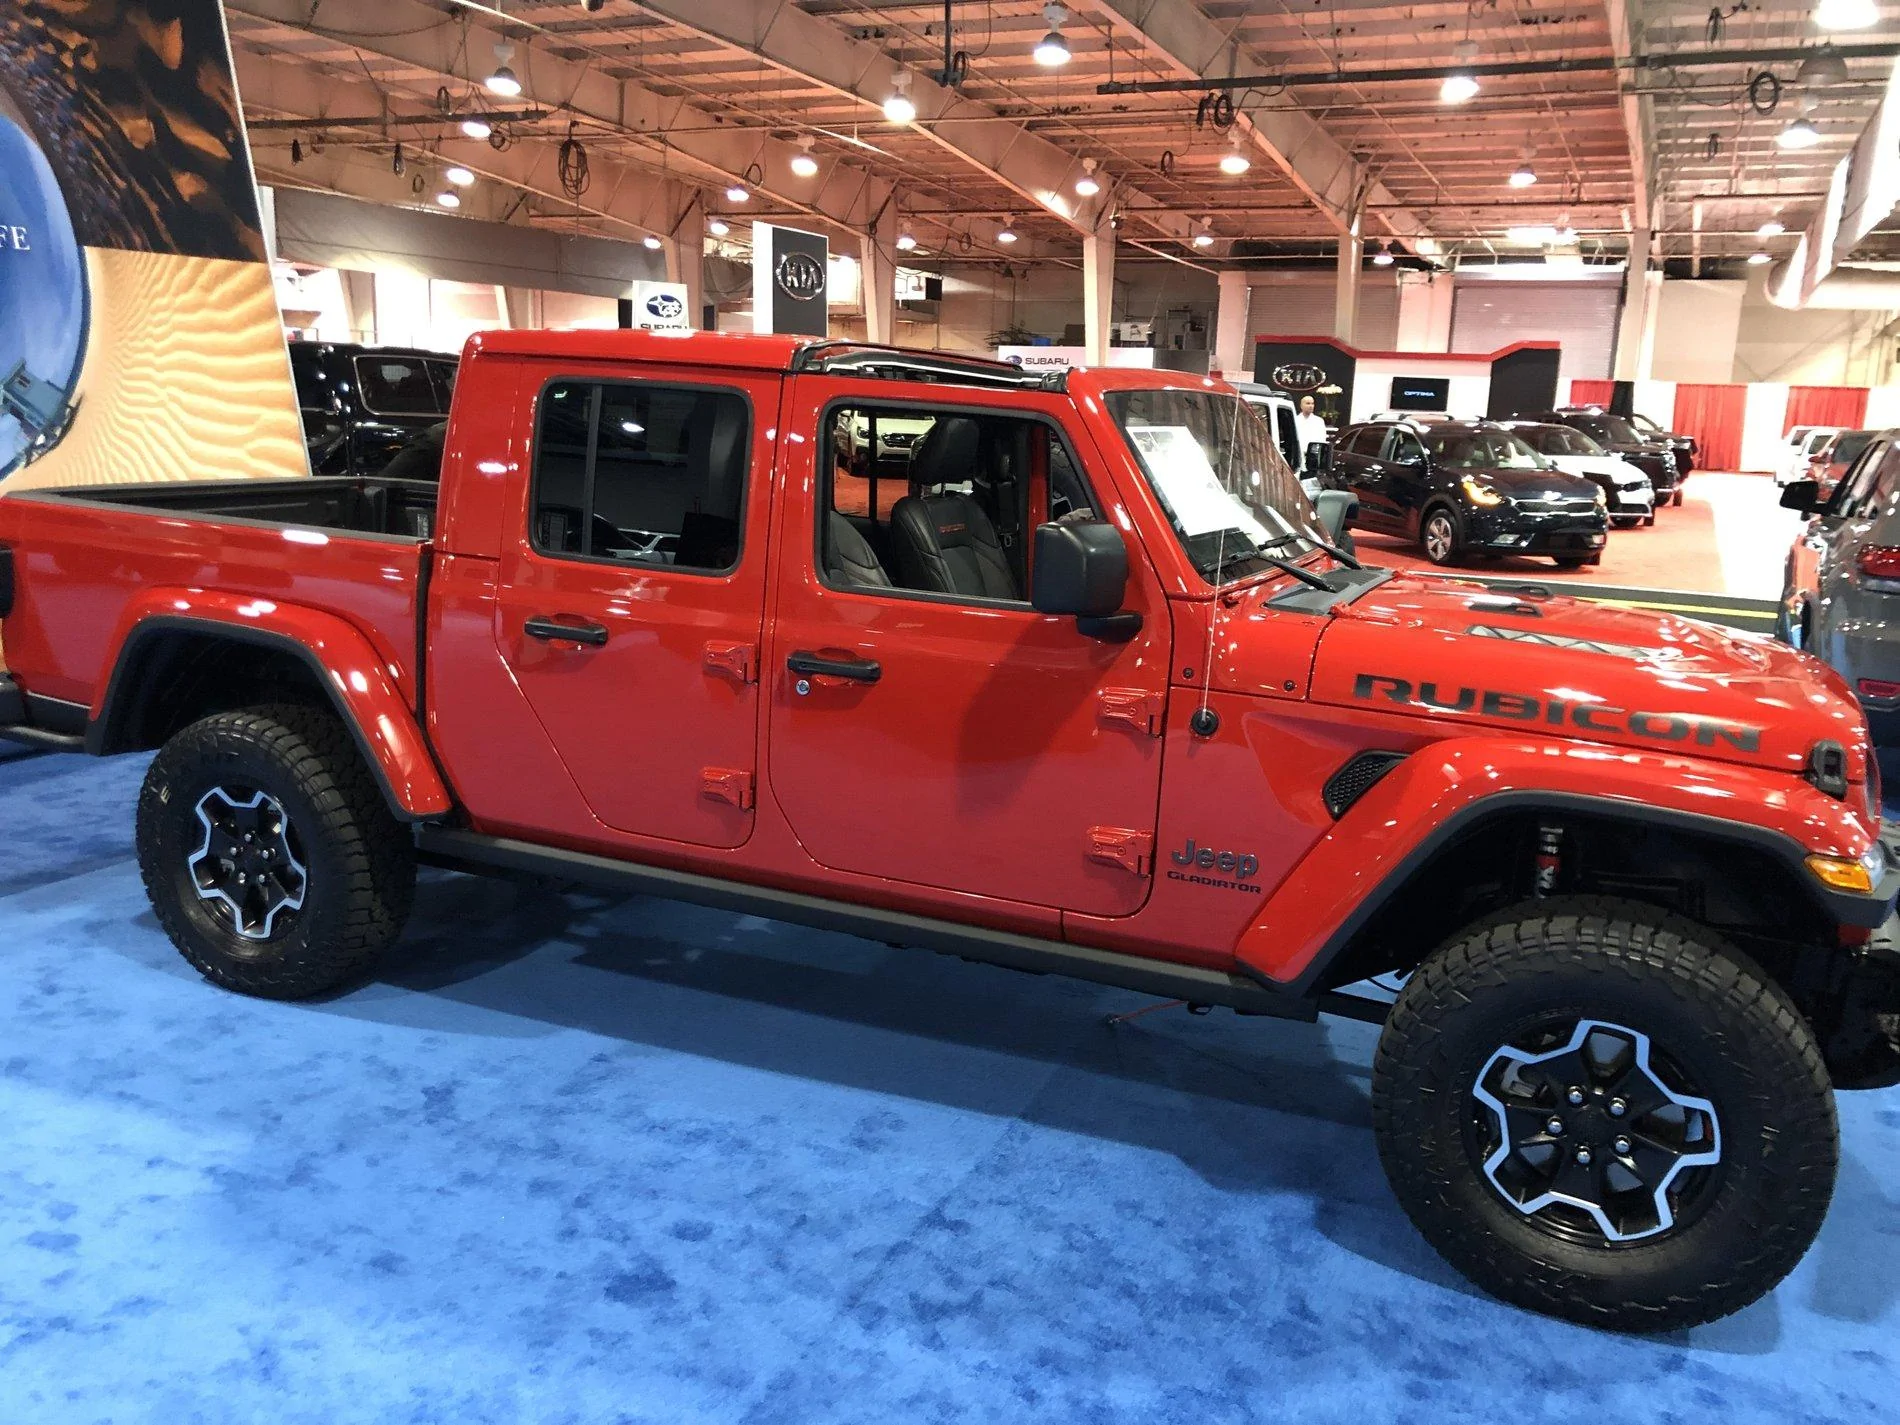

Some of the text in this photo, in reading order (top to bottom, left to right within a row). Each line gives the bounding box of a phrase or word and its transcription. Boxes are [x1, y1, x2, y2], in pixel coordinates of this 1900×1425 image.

[1025, 357, 1069, 365] SUBARU
[1281, 369, 1316, 384] KIA
[1355, 673, 1761, 752] RUBICON
[1172, 838, 1258, 879] Jeep
[1166, 870, 1261, 894] GLADIATOR
